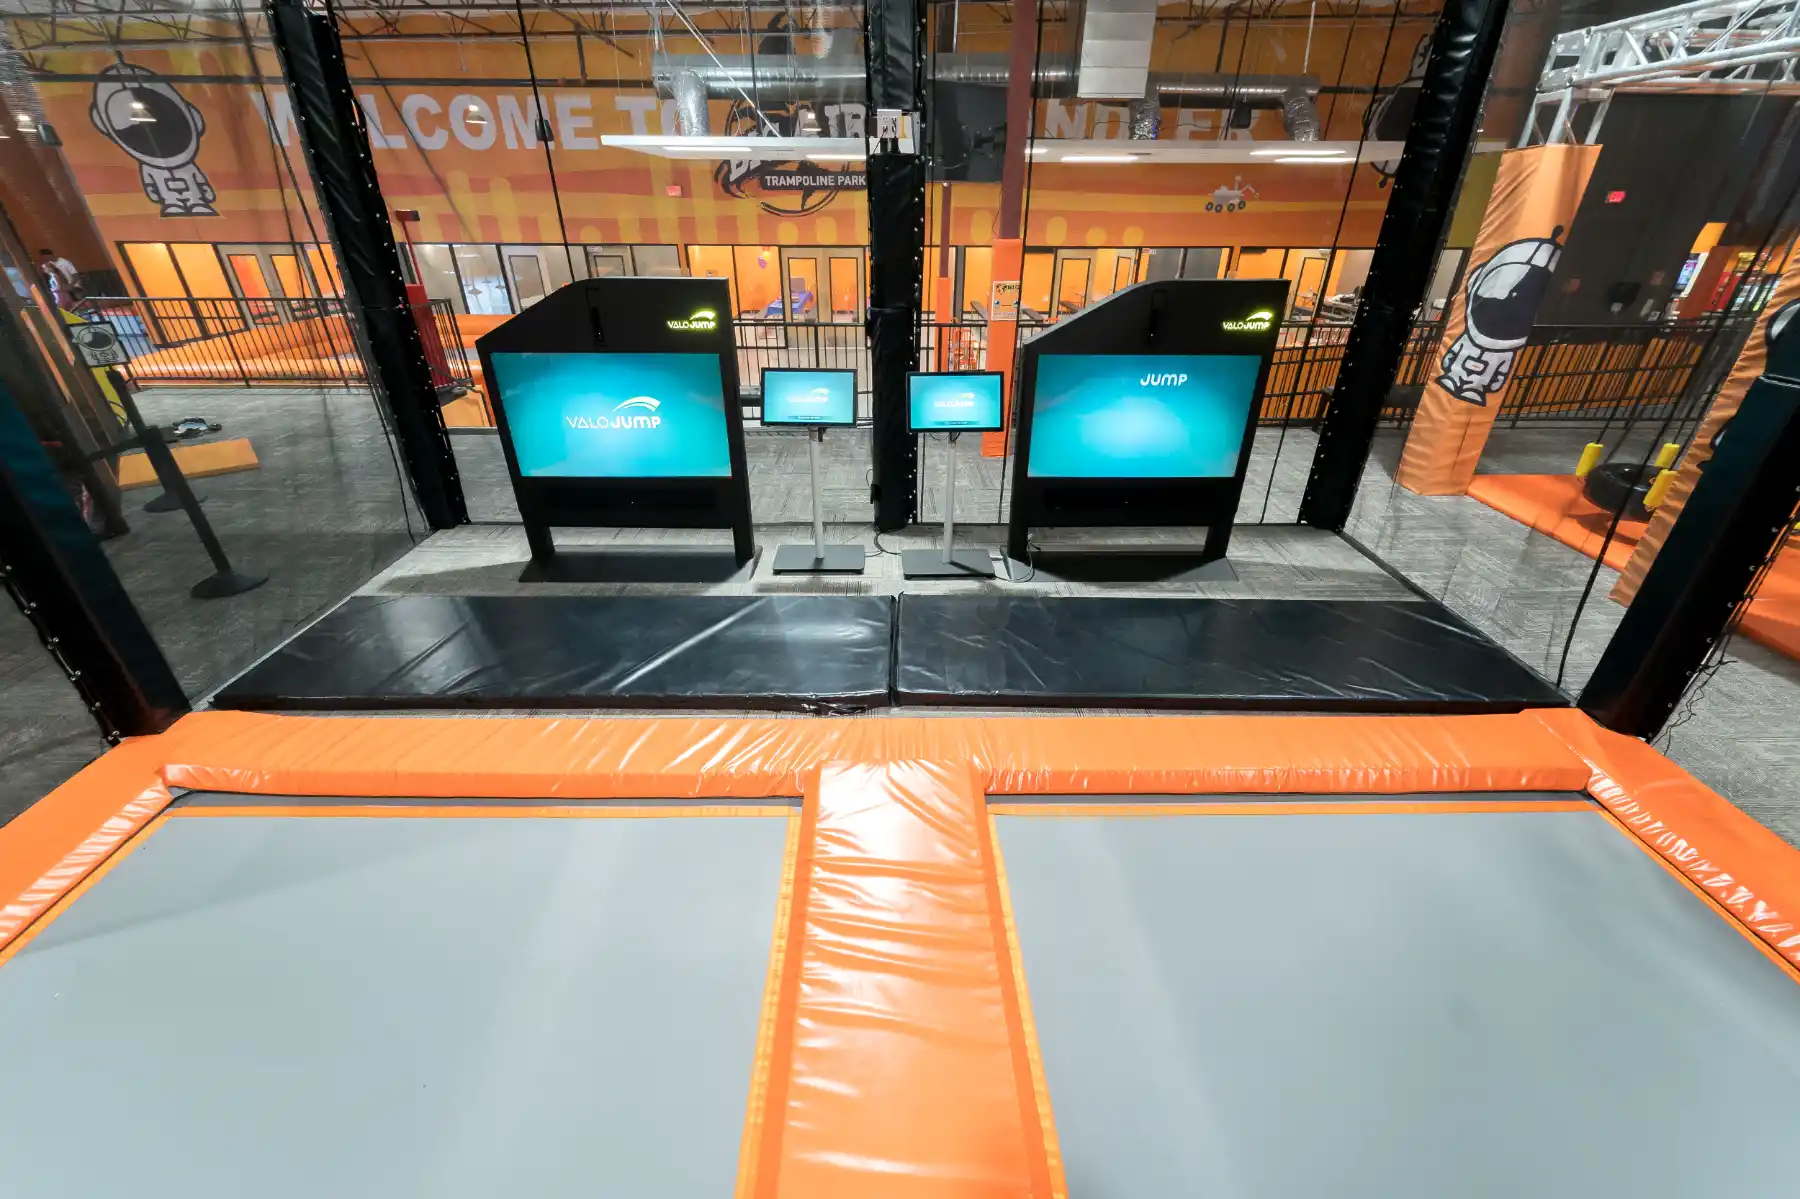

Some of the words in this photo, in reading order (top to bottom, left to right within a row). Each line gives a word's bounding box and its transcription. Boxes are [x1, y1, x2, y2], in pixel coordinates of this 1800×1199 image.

[250, 91, 599, 151] WLCOME
[764, 175, 835, 186] TRAMPOLINE
[837, 175, 867, 186] PARK
[1140, 373, 1188, 386] JUMP
